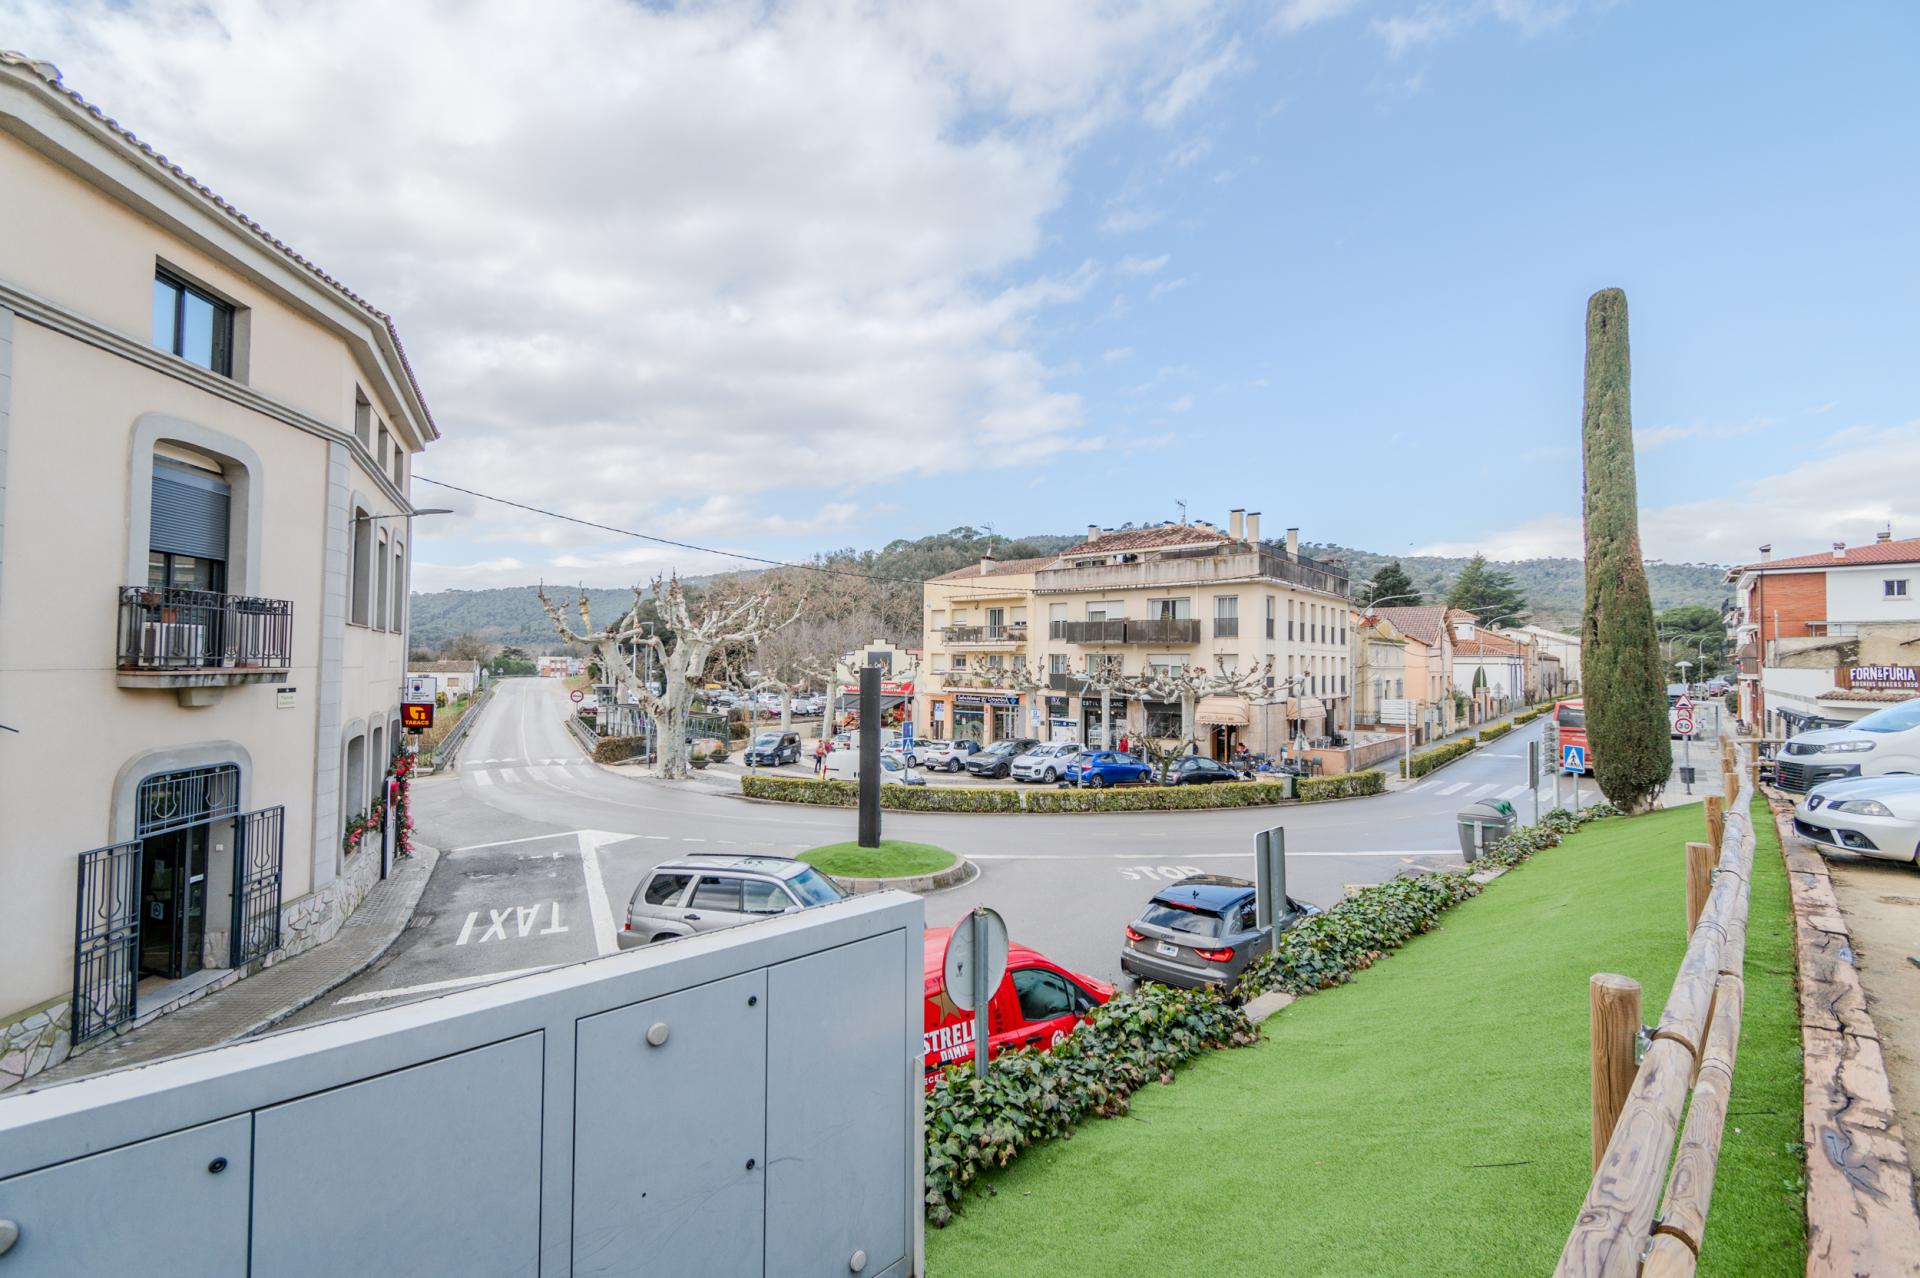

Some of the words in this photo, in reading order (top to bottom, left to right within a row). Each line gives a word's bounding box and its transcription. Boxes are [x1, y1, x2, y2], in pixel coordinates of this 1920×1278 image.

[1678, 722, 1690, 730] 30
[455, 901, 569, 946] TAXI
[923, 1019, 977, 1056] STRELL
[940, 1044, 969, 1062] DAMM
